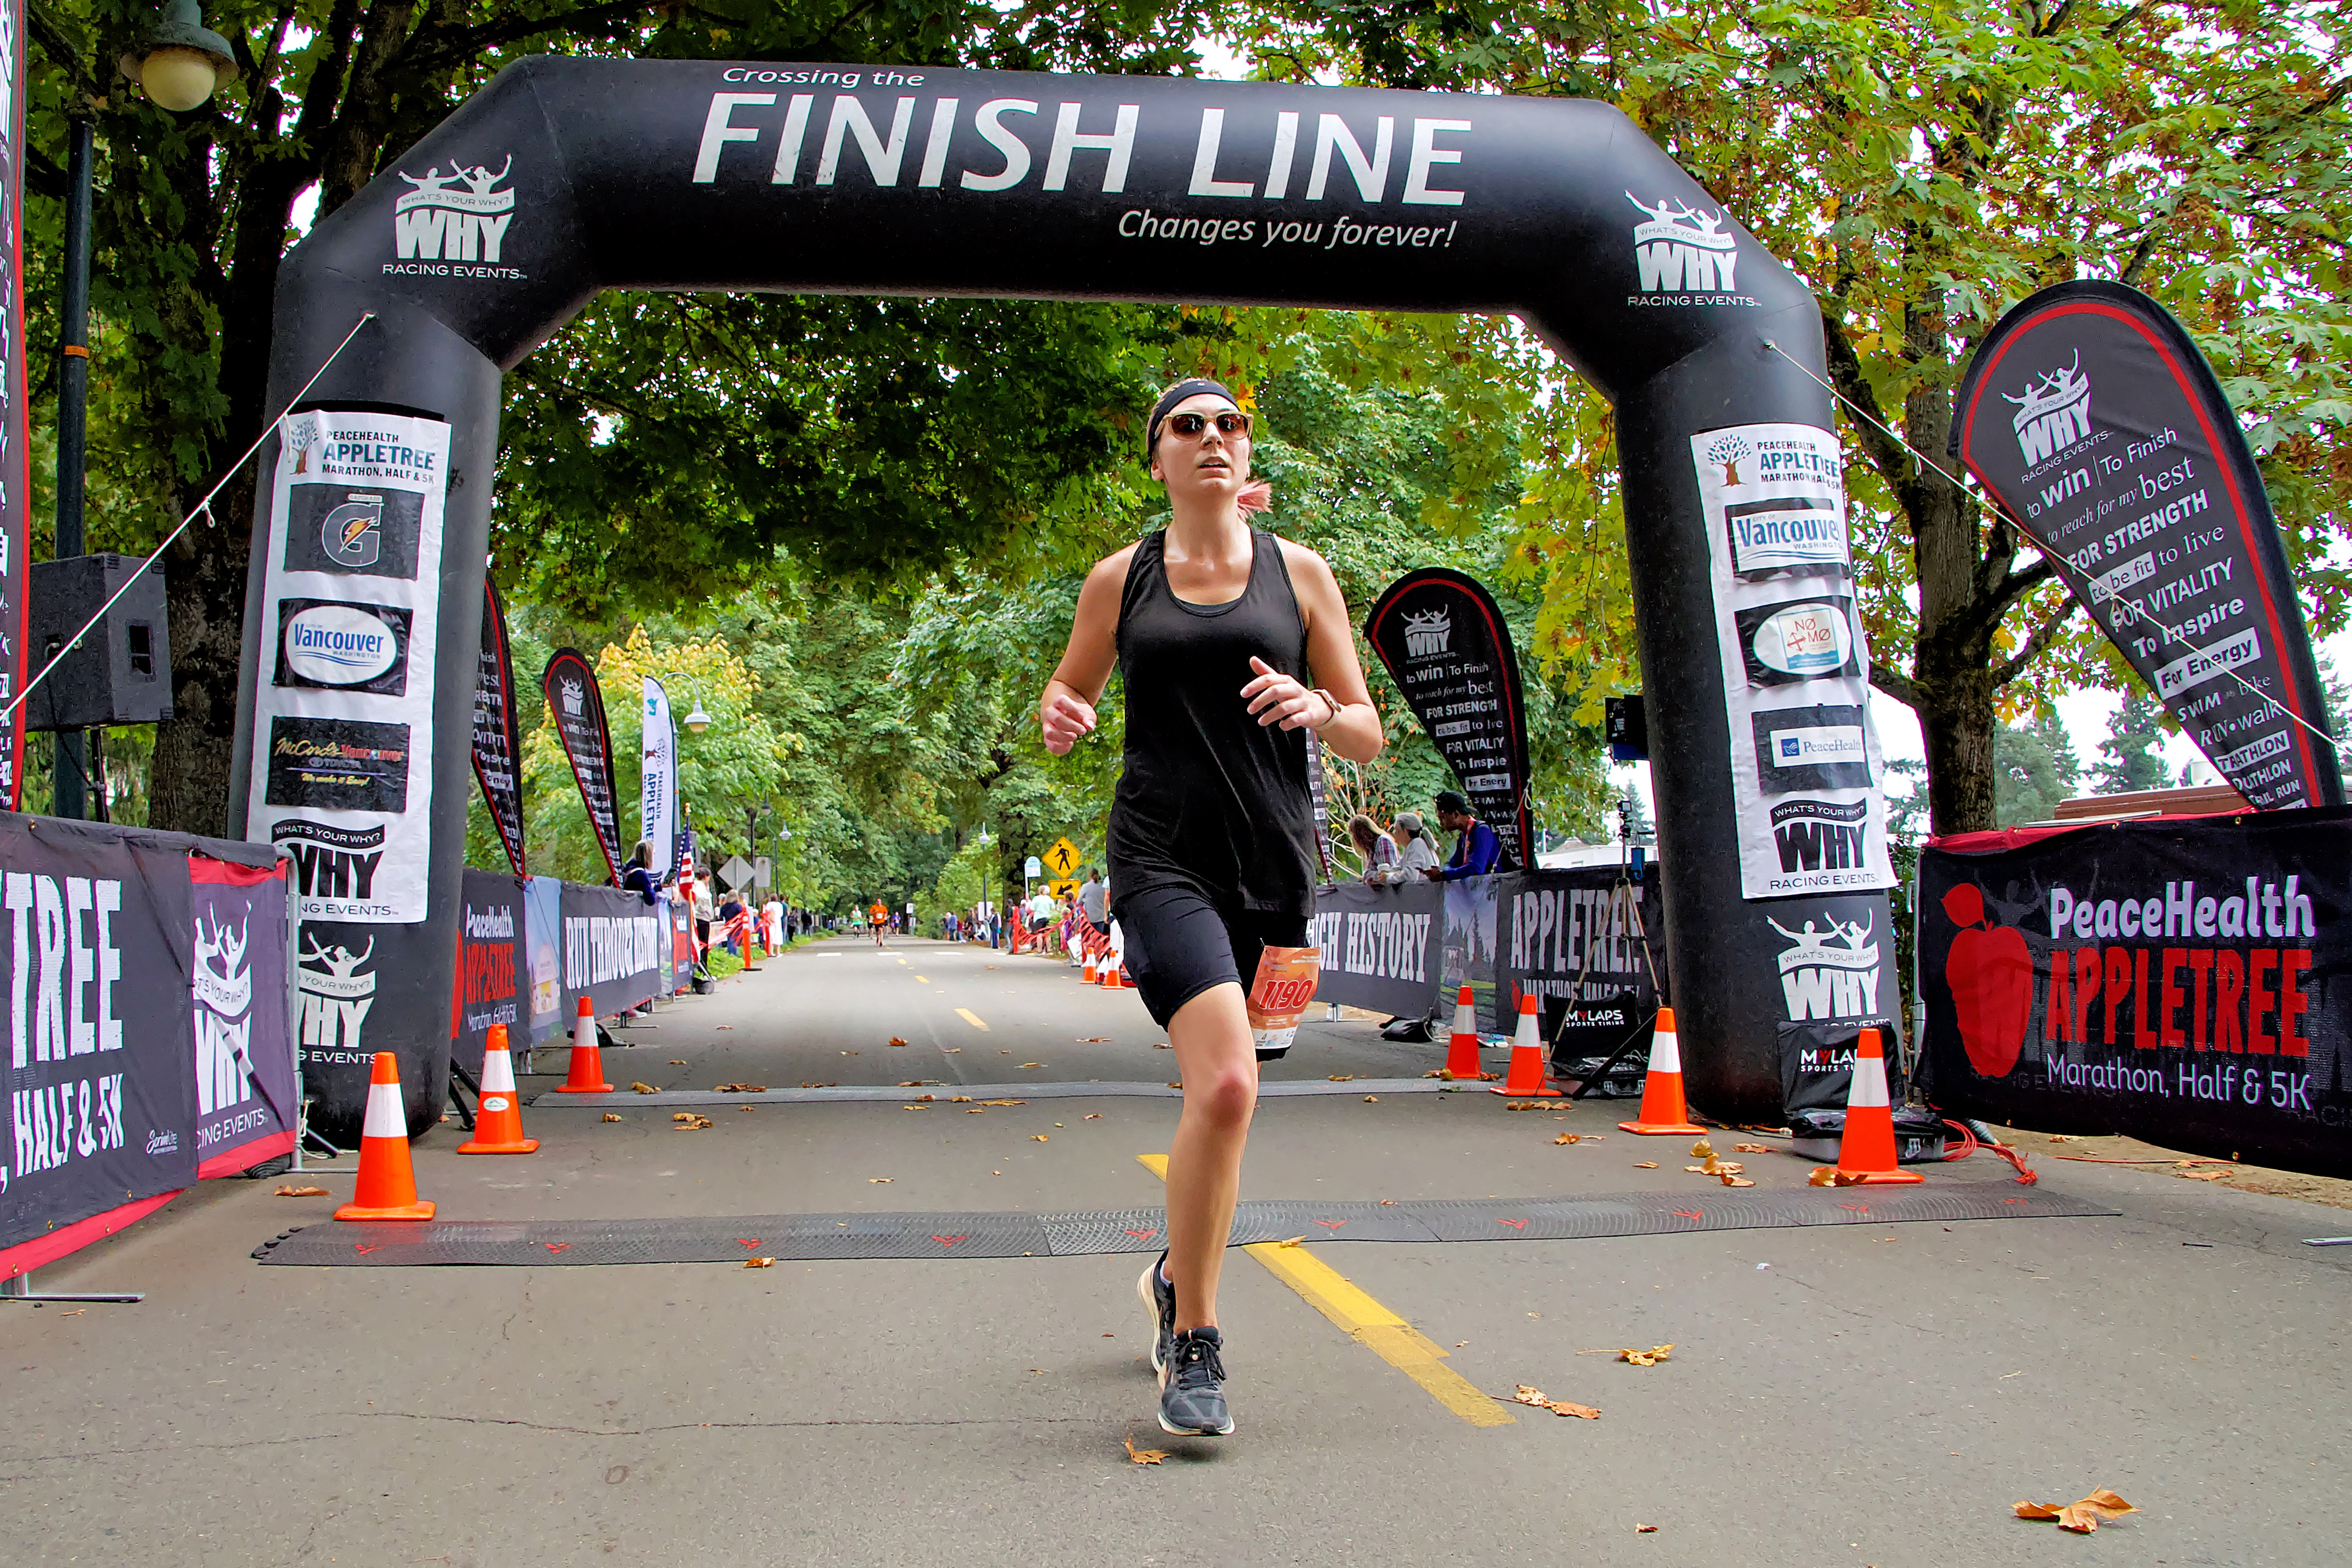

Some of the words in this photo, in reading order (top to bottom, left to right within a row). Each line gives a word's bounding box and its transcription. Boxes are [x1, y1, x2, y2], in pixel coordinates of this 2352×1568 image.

[723, 68, 861, 88] Crossing
[872, 71, 925, 86] the
[693, 92, 1139, 193] FINISH
[1188, 108, 1471, 206] LINE
[402, 194, 442, 204] WHAT'S
[446, 196, 475, 205] YOUR
[478, 197, 509, 206] WHY?
[395, 209, 514, 262] WHY
[1118, 210, 1255, 245] Changes
[1263, 220, 1322, 247] you
[1325, 216, 1457, 250] forever!
[1680, 230, 1706, 242] YOUR
[383, 264, 449, 276] RACING
[453, 266, 520, 279] EVENTS
[1636, 242, 1737, 291] WHY
[1628, 296, 1690, 306] RACING
[1695, 296, 1754, 307] EVENTS
[2015, 403, 2042, 424] WHAT'S
[2044, 396, 2064, 408] YOUR
[2065, 381, 2085, 399] WHY?
[326, 430, 399, 442] PEACEHEALTH
[2017, 391, 2091, 468] WHY
[323, 443, 435, 470] APPLETREE
[1757, 441, 1815, 451] PEACEHEALTH
[2021, 457, 2061, 484] RACING
[2064, 431, 2109, 460] EVENTS
[323, 464, 382, 477] MARATHON,
[385, 468, 412, 479] HALF
[413, 472, 419, 481] &
[422, 473, 434, 484] 5K
[2026, 501, 2041, 518] to
[2040, 466, 2091, 510] win
[2099, 455, 2123, 475] To
[2126, 426, 2178, 463] Finish
[2048, 528, 2057, 544] to
[2061, 510, 2093, 538] reach
[2095, 496, 2115, 524] for
[2118, 488, 2138, 507] my
[2138, 456, 2195, 501] best
[1736, 518, 1841, 547] Vancouve
[2067, 541, 2102, 575] FOR
[2104, 489, 2210, 556] STRENGTH
[2110, 570, 2130, 589] be
[2134, 560, 2153, 579] fit
[2159, 548, 2178, 566] to
[2183, 526, 2225, 554] live
[2148, 557, 2234, 614] VITALITY
[295, 624, 384, 652] Vancouver
[1406, 629, 1450, 657] WHY
[2132, 636, 2157, 659] To
[2162, 598, 2245, 645] Inspire
[1406, 675, 1415, 683] to
[1416, 665, 1443, 682] win
[1449, 665, 1461, 675] To
[2161, 667, 2183, 690] For
[2187, 637, 2254, 678] Energy
[1467, 679, 1494, 695] best
[1426, 706, 1444, 719] FOR
[1446, 699, 1497, 716] STRENGTH
[2177, 691, 2222, 722] SWIM
[1472, 721, 1483, 730] to
[2276, 779, 2301, 798] RUN
[646, 773, 657, 840] APPLETRE
[1774, 805, 1814, 817] WHAT'S
[1816, 806, 1843, 816] YOUR
[1845, 806, 1864, 816] WHY?
[275, 825, 313, 835] WHAT'S
[316, 828, 347, 841] YOUR
[350, 832, 380, 843] WHY?
[1774, 821, 1867, 873] WHY
[1770, 875, 1828, 889] RACING
[1833, 873, 1876, 885] EVENTS
[327, 904, 390, 915] EVENTS
[2050, 875, 2315, 939] PeaceHealth
[1345, 912, 1431, 983] HISTORY
[1783, 951, 1824, 963] WHAT'S
[1827, 952, 1854, 961] YOUR
[1855, 950, 1876, 961] WHY?
[0, 870, 123, 1070] TREE
[305, 976, 335, 988] YOUR
[340, 981, 370, 991] WHY?
[210, 986, 230, 1004] YOUR
[230, 982, 249, 1003] WHY?
[1258, 979, 1314, 1010] 1190
[1781, 966, 1880, 1021] WHY
[2046, 946, 2312, 1057] APPLETREE
[1566, 1010, 1623, 1021] MYLAPS
[1801, 1049, 1858, 1064] MYLA
[2048, 1053, 2170, 1099] Marathon,
[2179, 1062, 2236, 1102] Half
[2242, 1069, 2261, 1104] &
[2271, 1071, 2312, 1111] 5K
[12, 1082, 74, 1178] HALF
[77, 1078, 97, 1158] &
[223, 1108, 265, 1139] EVENTS
